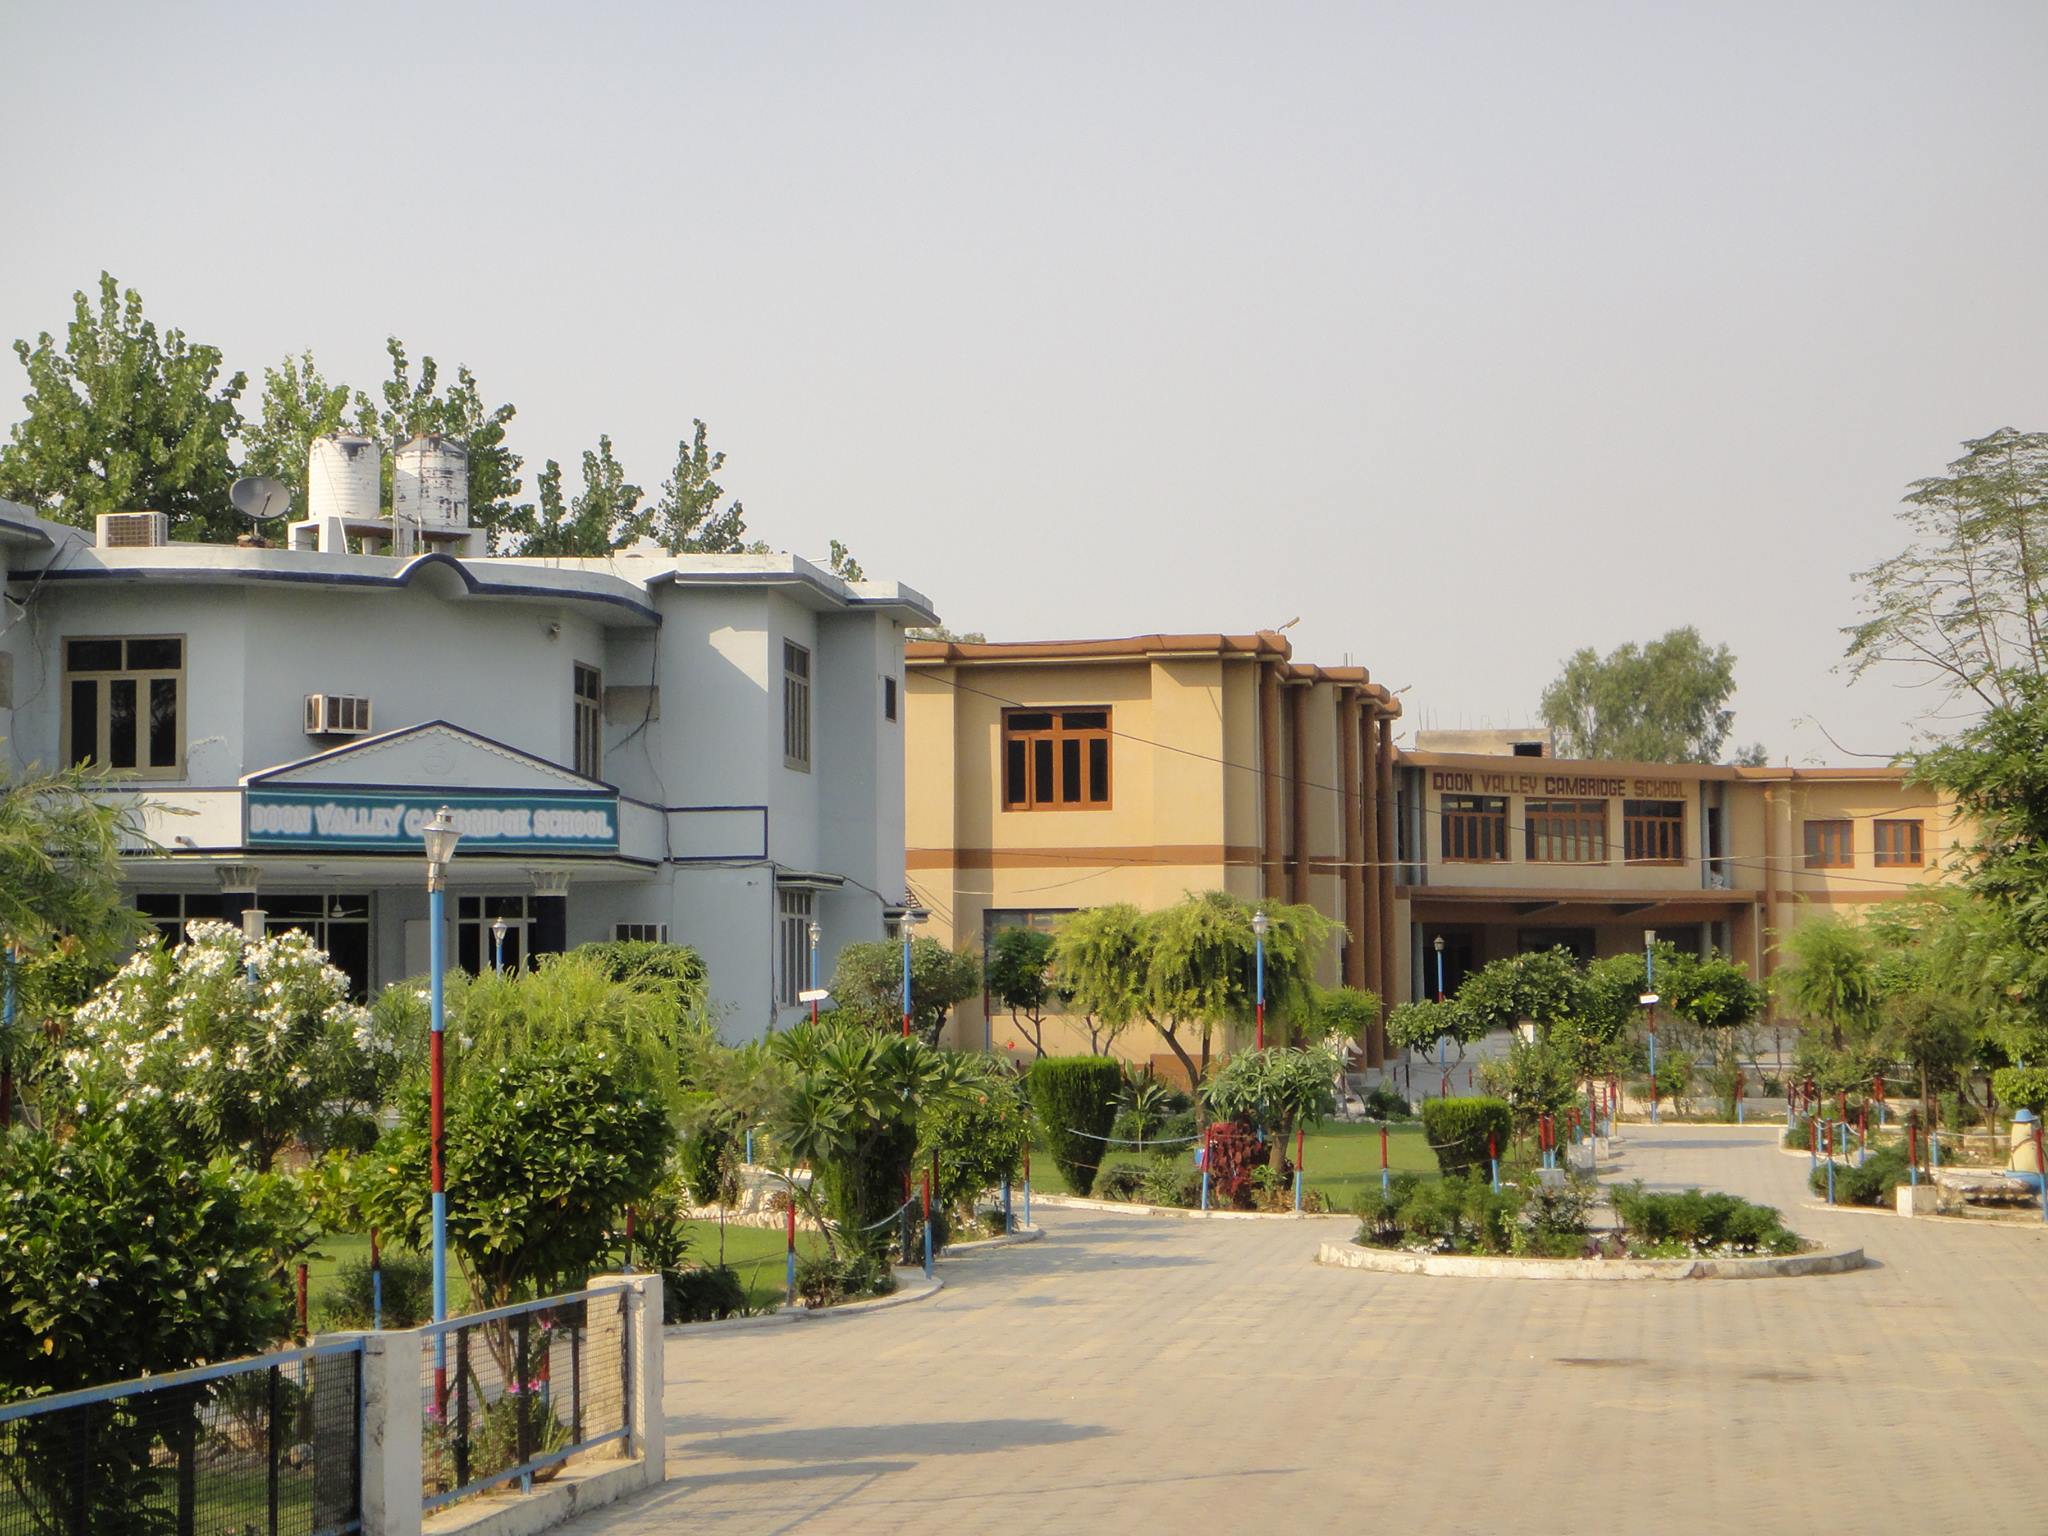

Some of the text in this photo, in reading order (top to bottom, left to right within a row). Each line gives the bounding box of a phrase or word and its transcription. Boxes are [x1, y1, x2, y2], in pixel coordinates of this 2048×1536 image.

[1432, 772, 1688, 799] DOON VALLEY CAMBRIDGE SCHOOL
[250, 802, 614, 838] DOON VALLEY CABRIDGE SCHOOL
